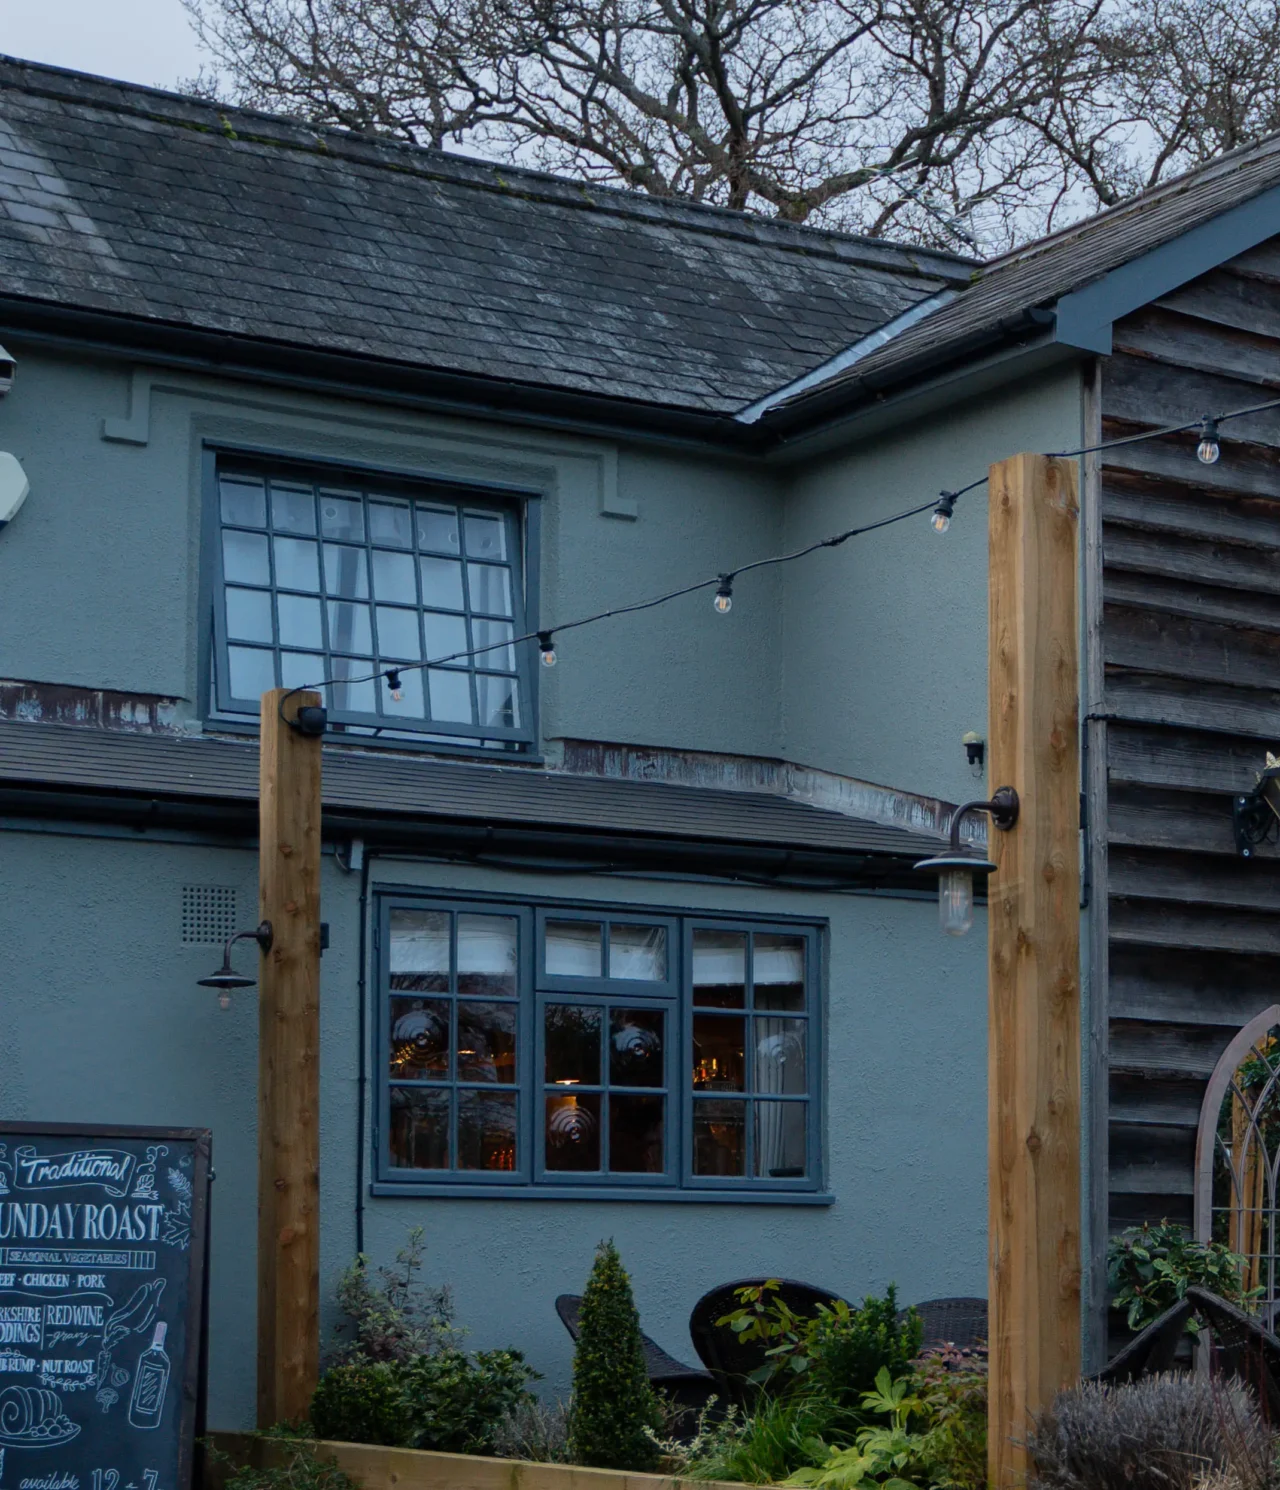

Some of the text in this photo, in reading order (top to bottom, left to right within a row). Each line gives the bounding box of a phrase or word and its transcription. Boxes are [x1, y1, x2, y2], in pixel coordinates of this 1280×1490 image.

[21, 1154, 131, 1184] Traditional
[83, 1203, 165, 1241] ROAST
[9, 1251, 128, 1265] SEASONAL VEGETABLES
[23, 1273, 70, 1288] CHICKEN
[78, 1274, 106, 1288] PORK
[49, 1331, 92, 1348] gravy
[8, 1358, 36, 1372] RUMP
[42, 1360, 64, 1373] NUT
[64, 1360, 95, 1374] ROAST
[19, 1471, 80, 1490] available
[92, 1468, 120, 1490] 12
